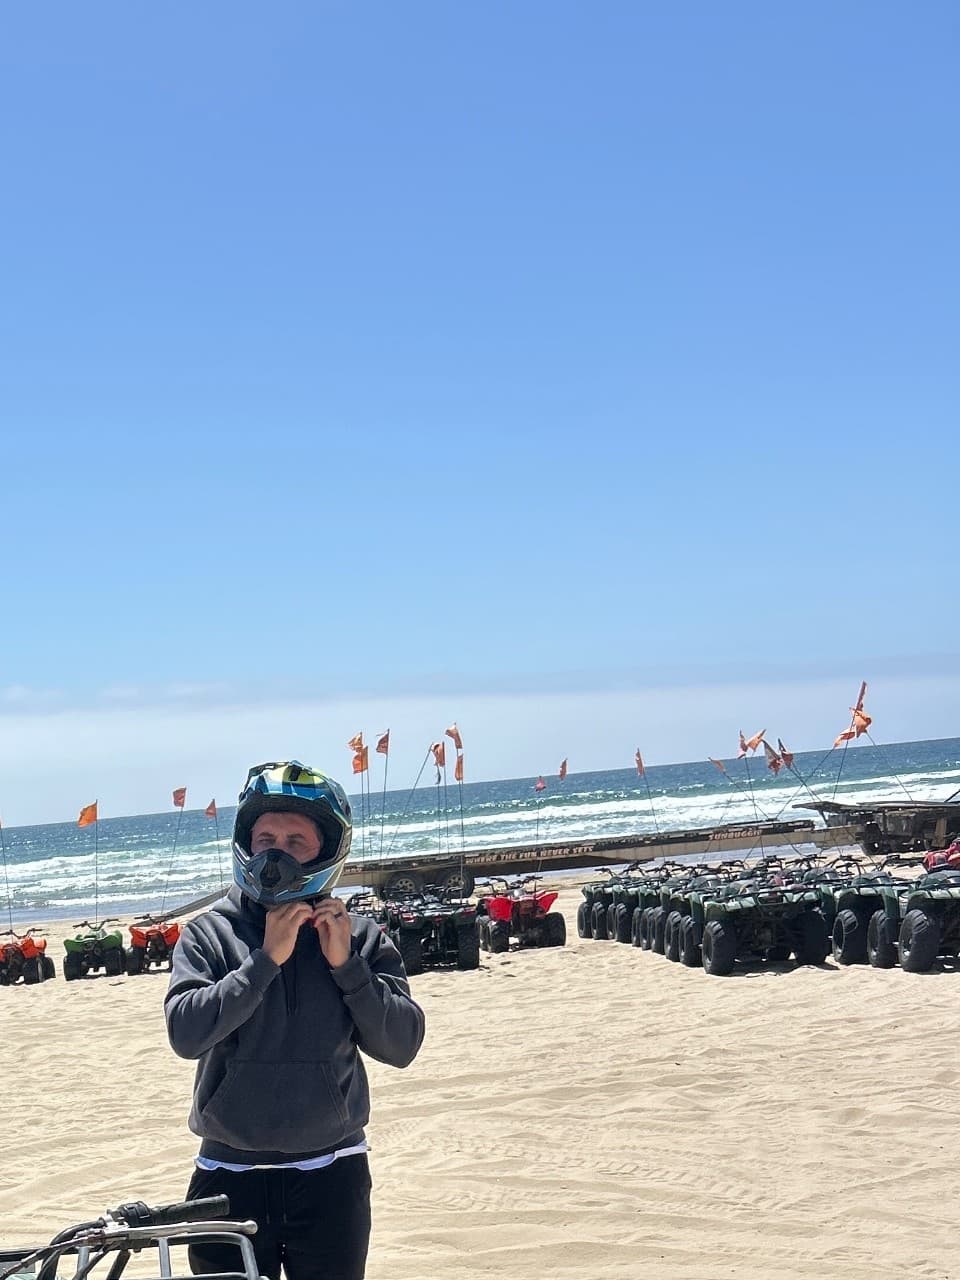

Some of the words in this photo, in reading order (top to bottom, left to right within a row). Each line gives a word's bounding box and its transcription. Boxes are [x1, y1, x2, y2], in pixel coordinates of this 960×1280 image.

[501, 853, 516, 861] THE
[519, 851, 537, 859] FUN
[540, 849, 569, 857] NEVER
[572, 846, 594, 854] SETS
